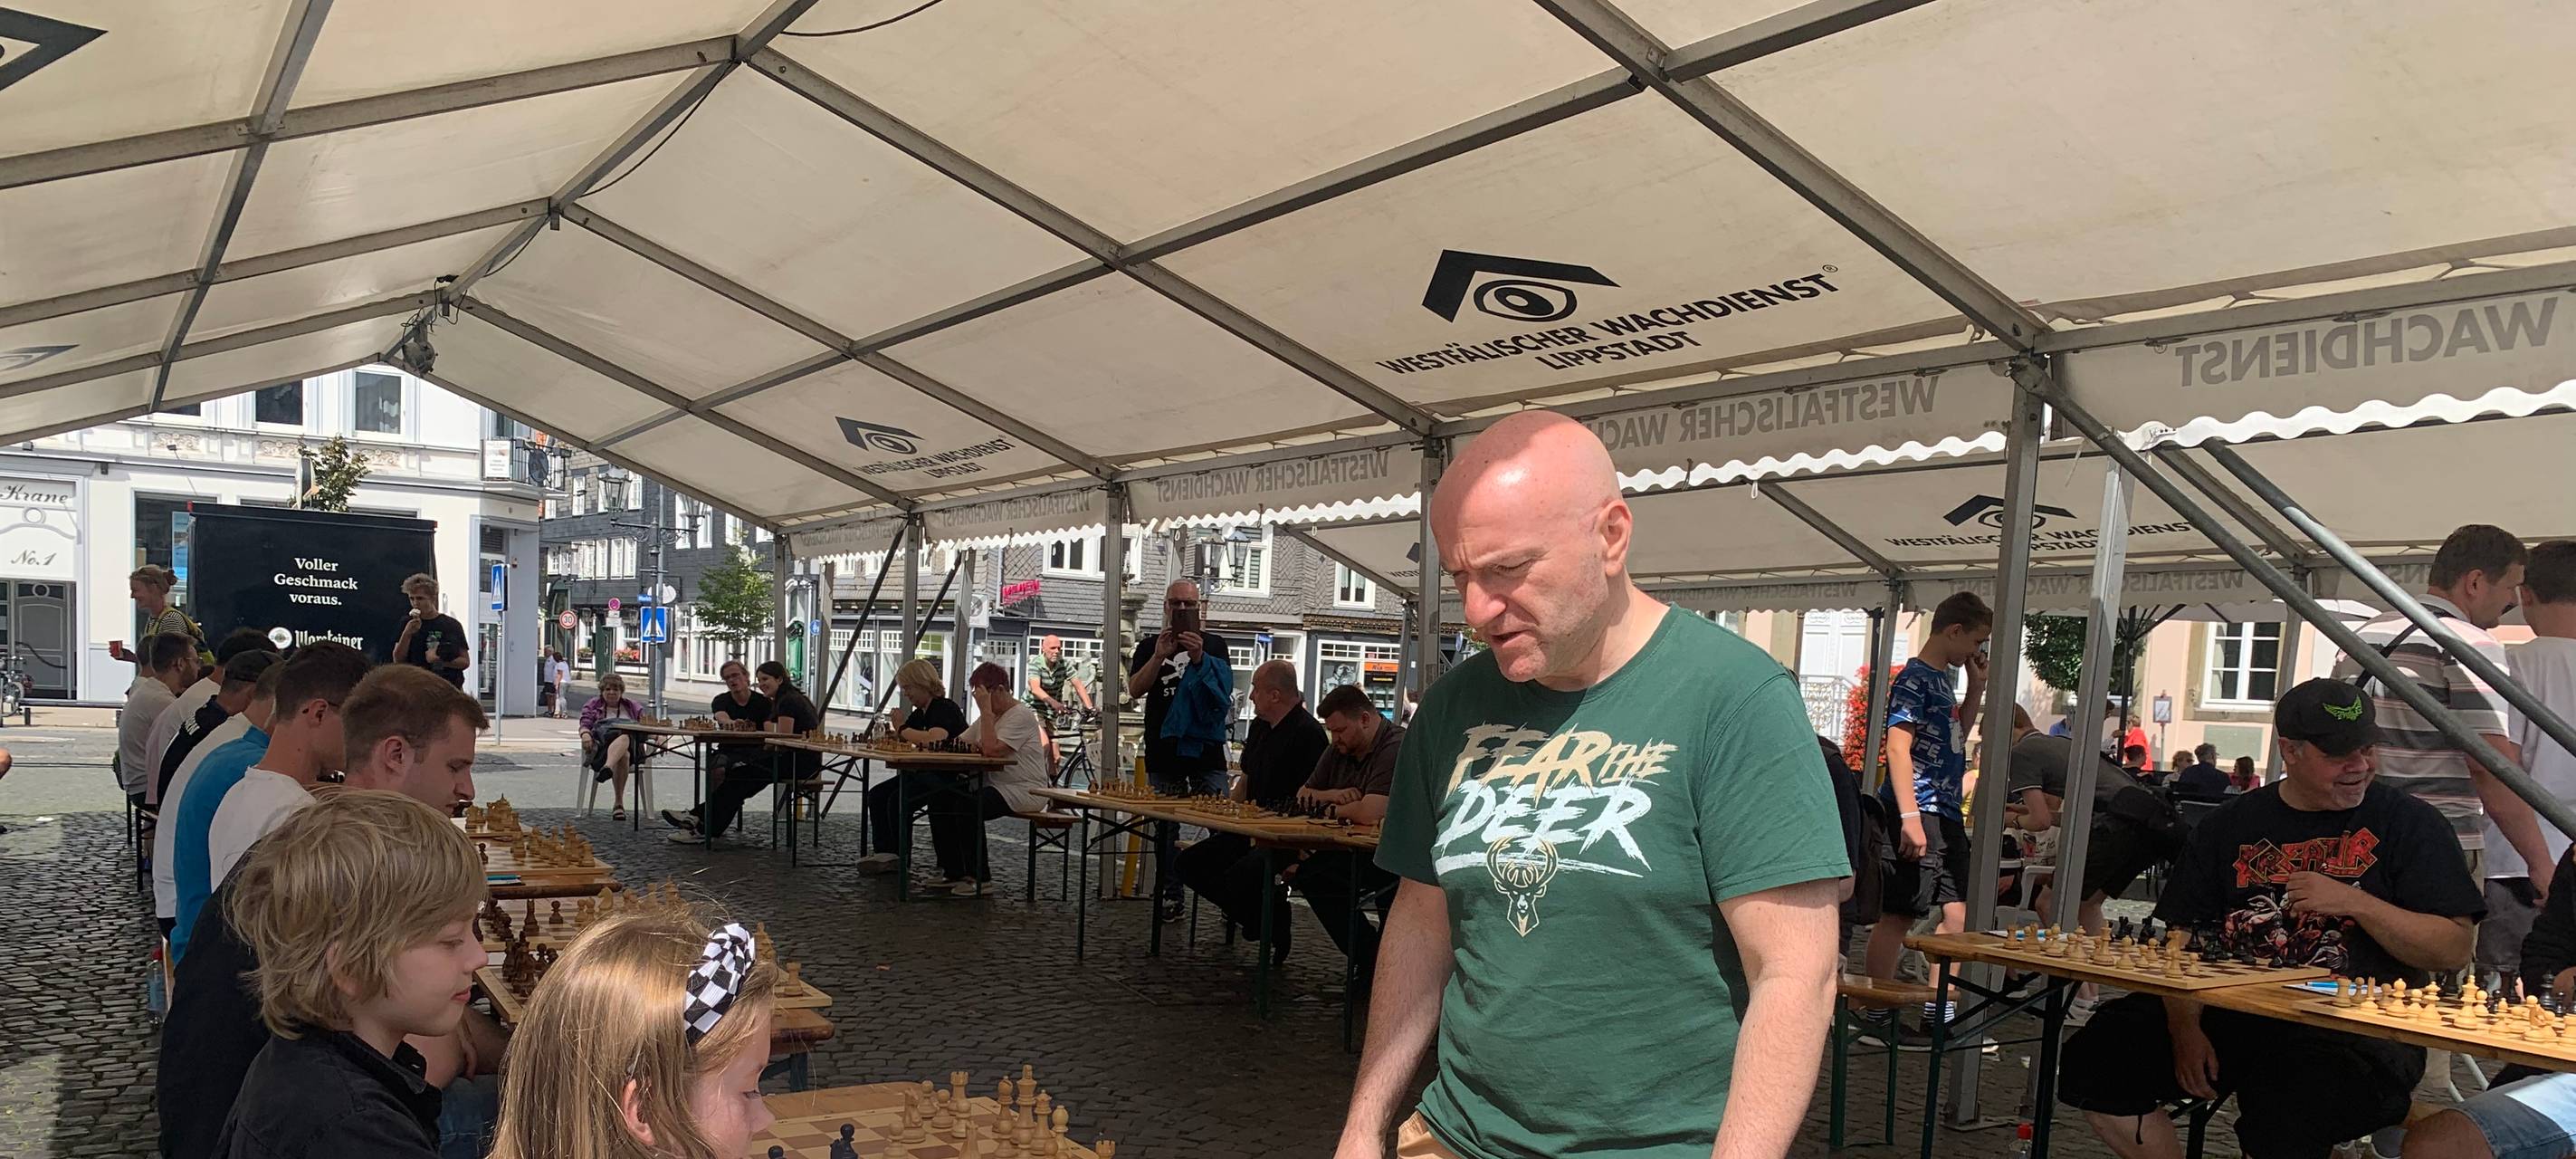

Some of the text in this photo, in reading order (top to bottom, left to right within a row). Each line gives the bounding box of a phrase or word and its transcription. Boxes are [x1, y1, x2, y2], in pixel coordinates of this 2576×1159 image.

[1376, 326, 1600, 375] WESTFÄLISCHER
[1535, 330, 1702, 370] LIPPSTADT
[294, 558, 339, 571] Voller
[273, 573, 358, 590] Geschmack
[289, 593, 342, 606] voraus.
[564, 616, 573, 624] 30
[1445, 723, 1678, 806] FEAR THE
[1431, 777, 1652, 871] DEER
